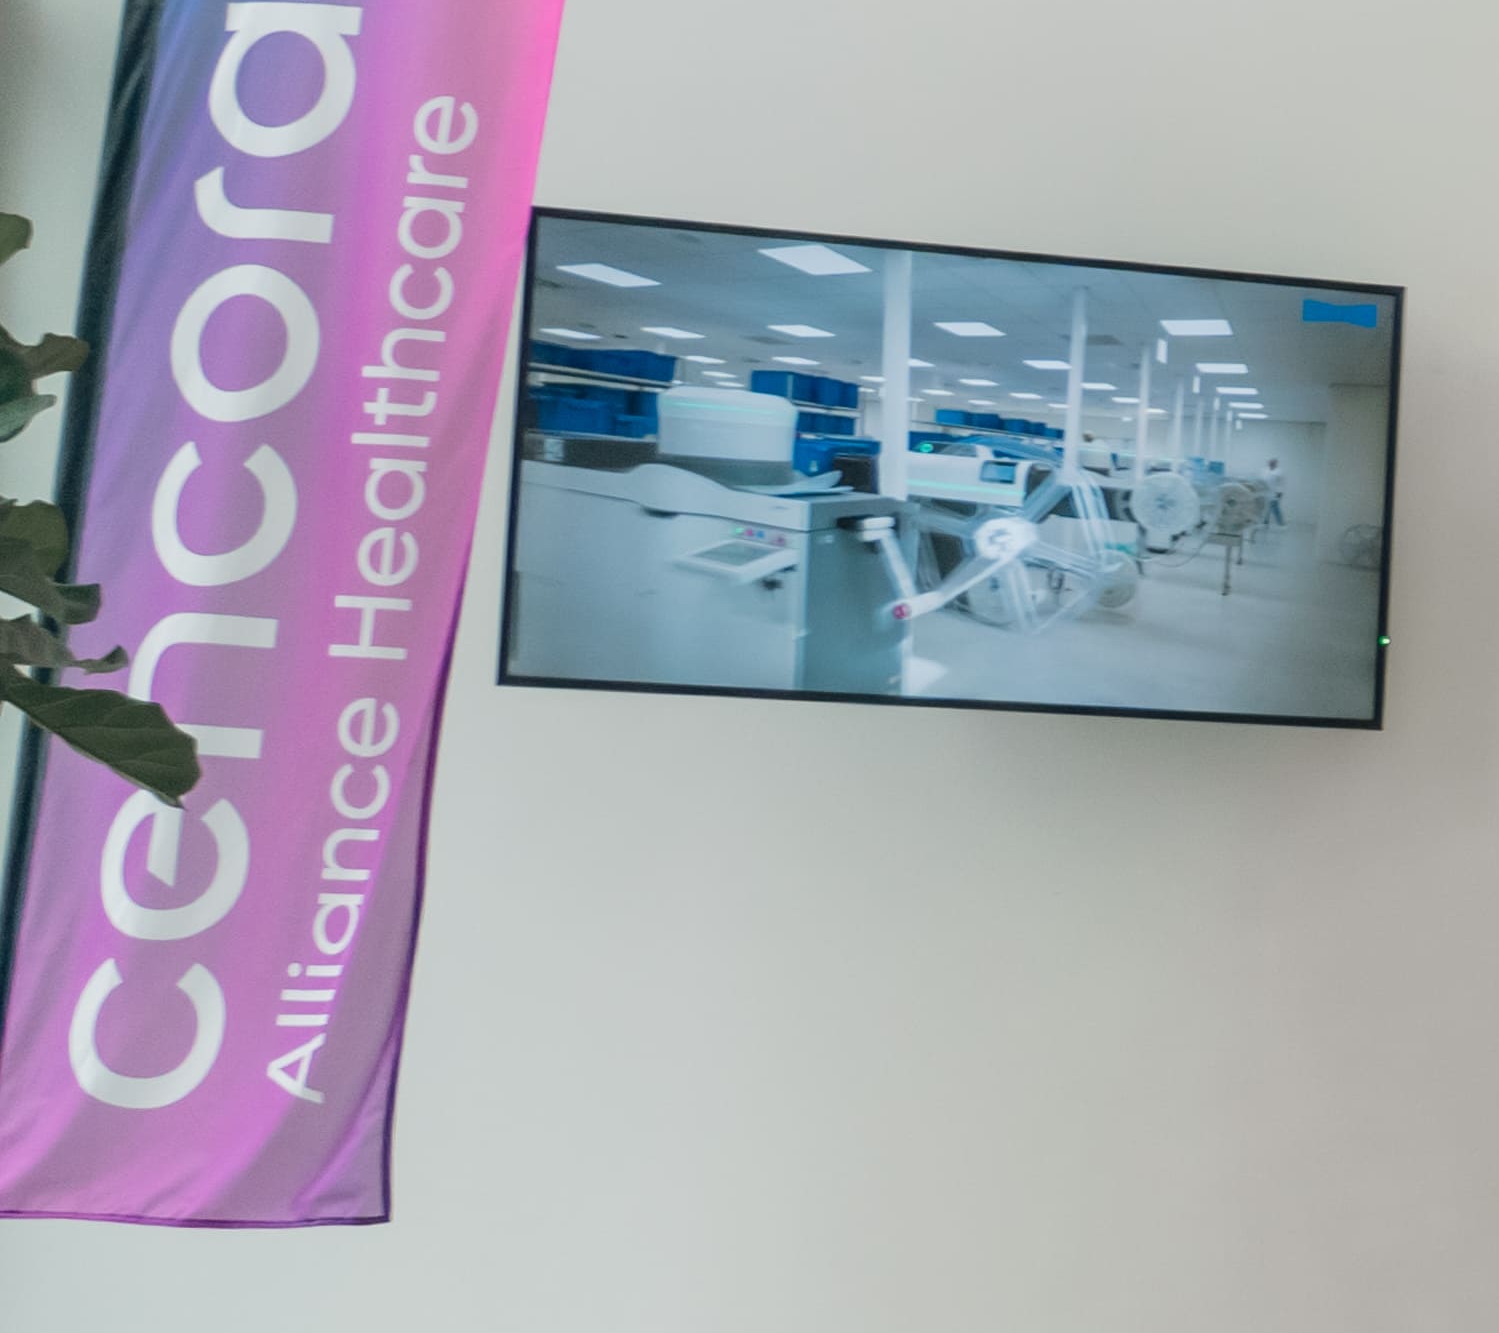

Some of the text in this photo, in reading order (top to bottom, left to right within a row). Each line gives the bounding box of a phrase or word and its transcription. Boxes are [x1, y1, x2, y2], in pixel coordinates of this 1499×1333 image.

[69, 1, 363, 1109] cencora
[266, 95, 479, 1105] Alliance Healthcare
